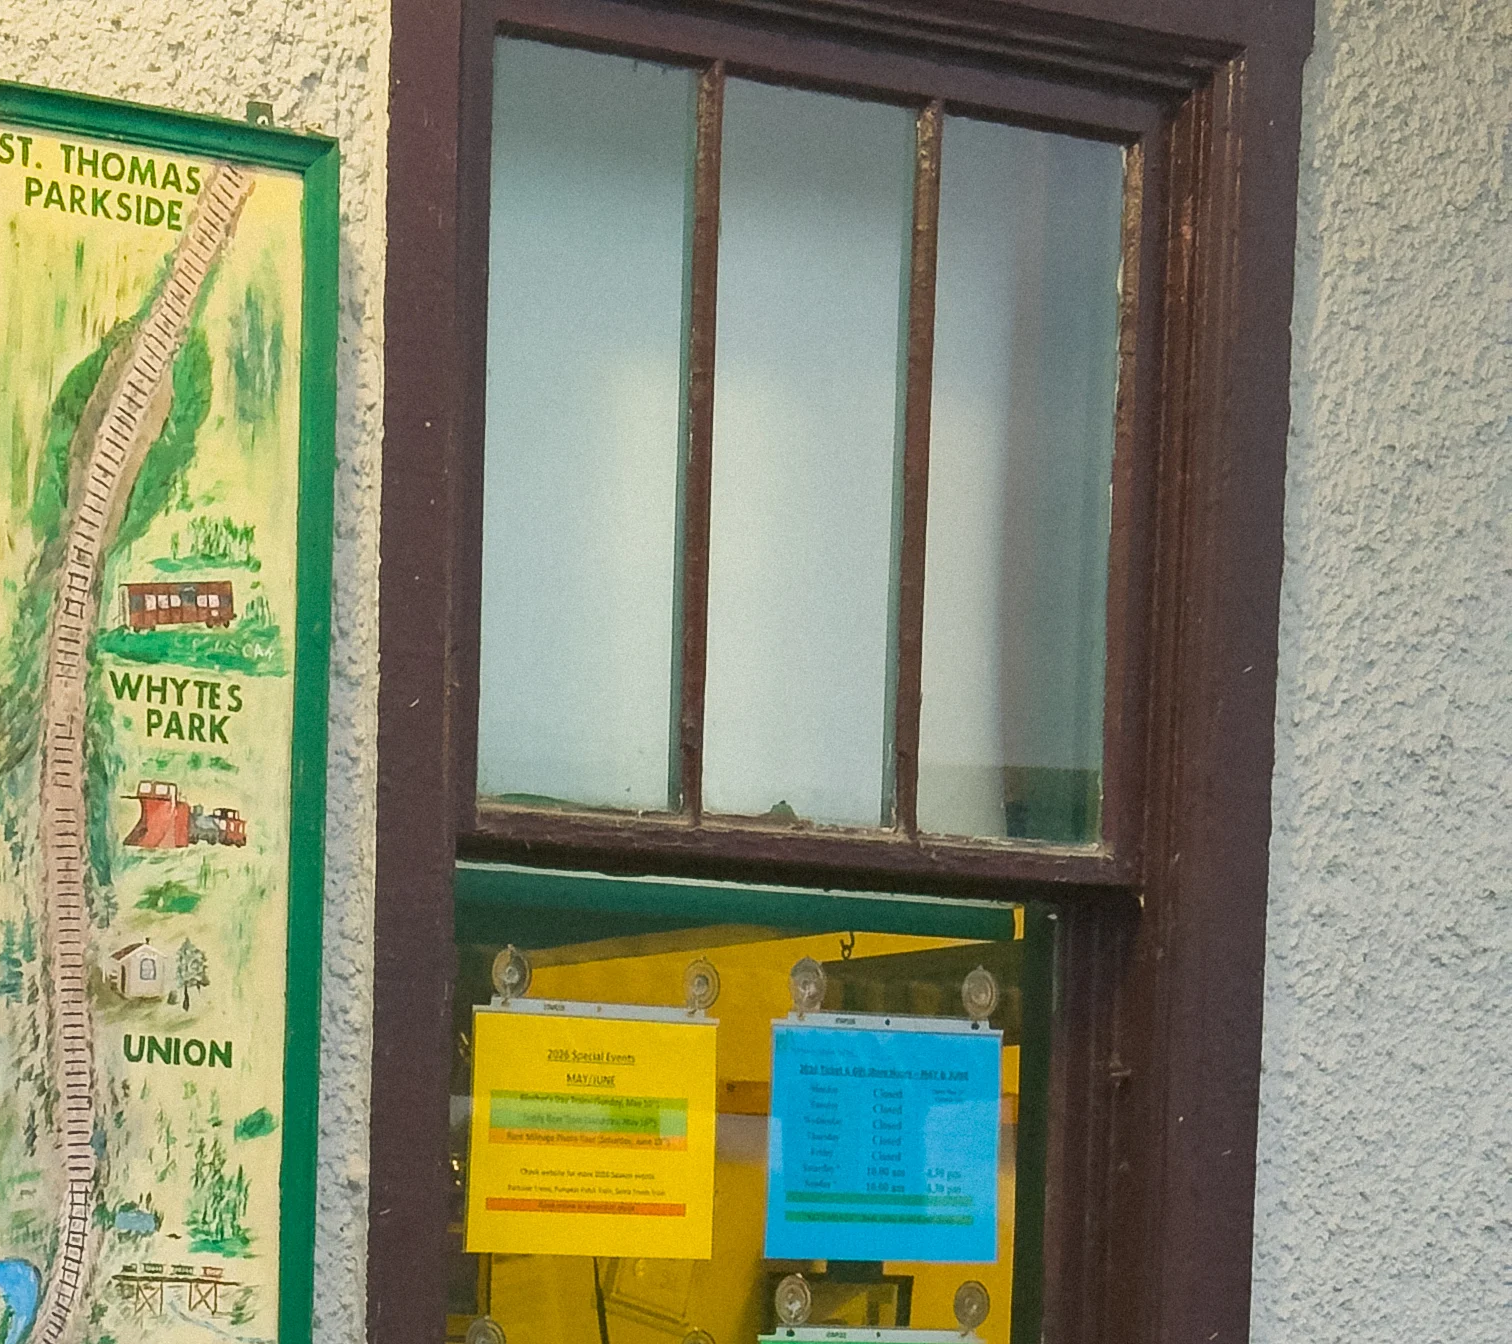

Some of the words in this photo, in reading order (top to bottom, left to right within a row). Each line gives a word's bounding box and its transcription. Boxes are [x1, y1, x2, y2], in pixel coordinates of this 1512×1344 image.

[60, 143, 202, 196] THOMAS
[24, 176, 184, 233] PARKSIDE
[109, 670, 243, 713] WHYTES
[146, 708, 230, 745] PARK
[123, 1033, 233, 1069] UNION
[572, 1051, 604, 1065] Special
[606, 1053, 635, 1064] Events
[566, 1073, 616, 1086] MAY/JUNE
[872, 1104, 903, 1115] Closed
[872, 1119, 903, 1130] Closed
[872, 1135, 902, 1146] Closed
